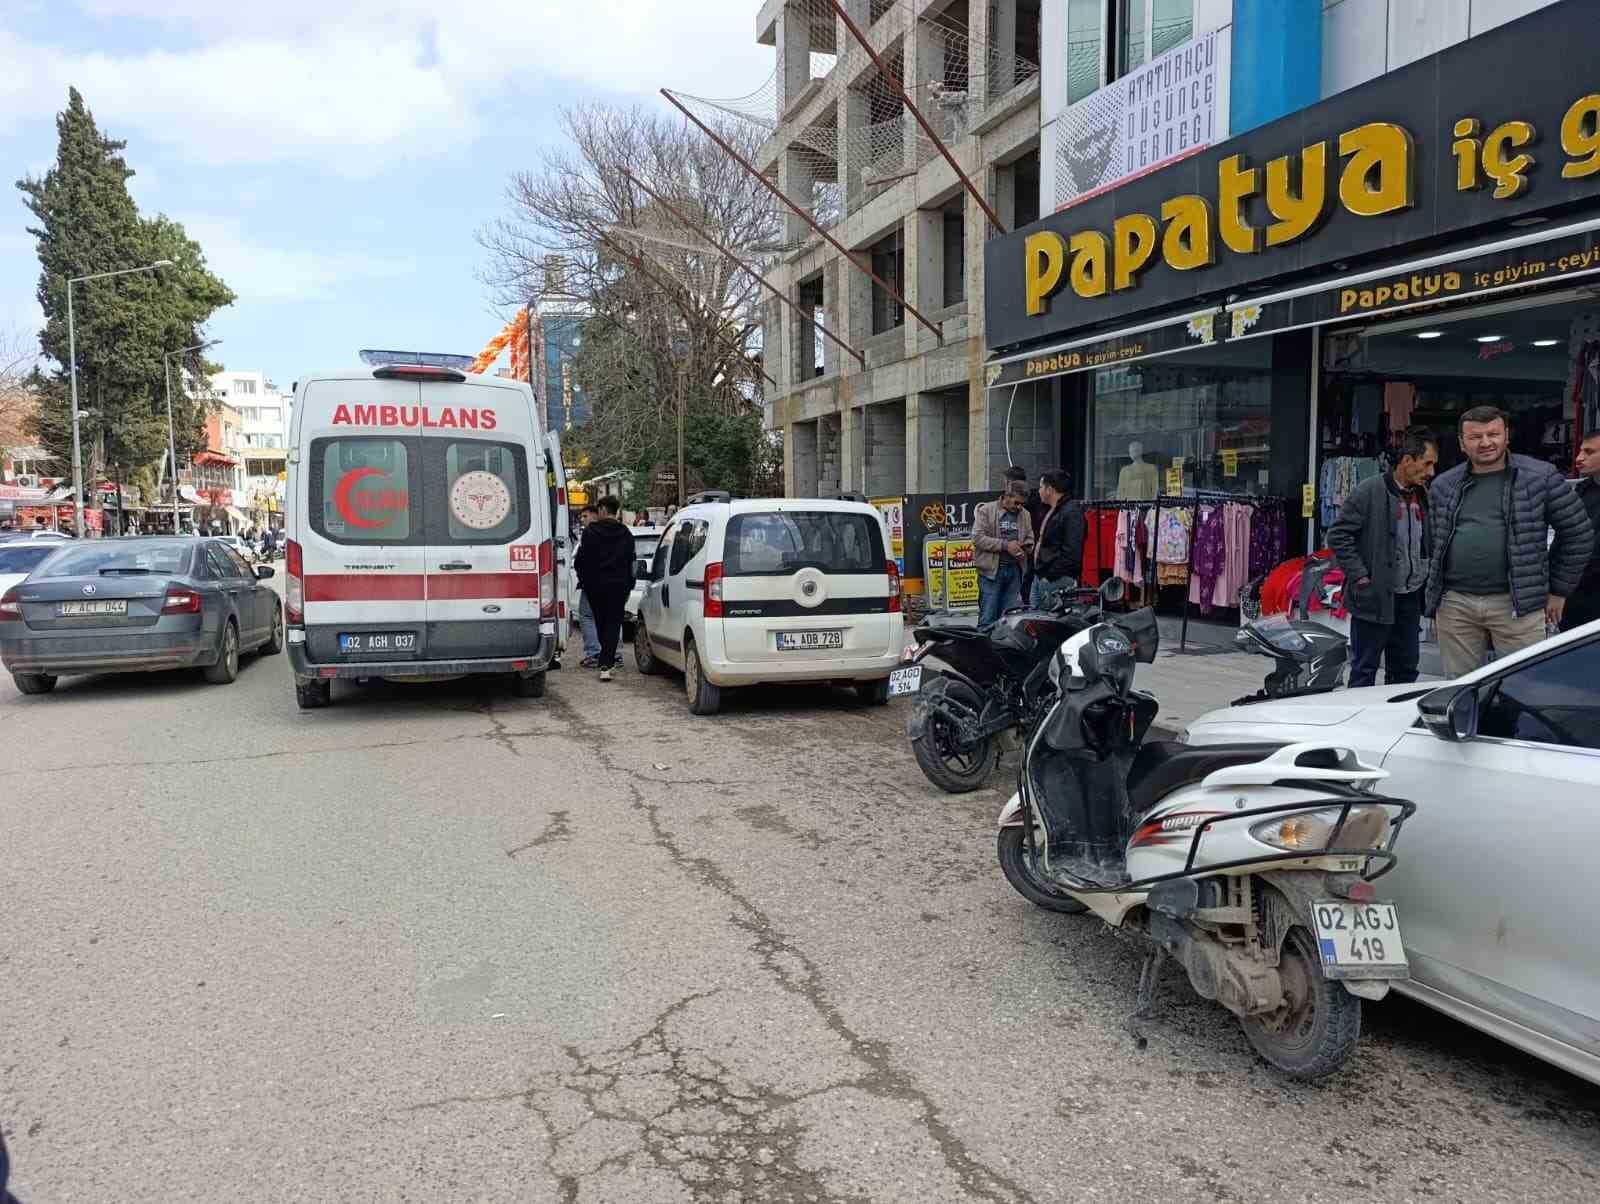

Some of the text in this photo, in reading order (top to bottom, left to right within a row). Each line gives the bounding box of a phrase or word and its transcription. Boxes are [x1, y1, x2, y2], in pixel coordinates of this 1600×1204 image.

[1128, 32, 1214, 107] ATATÜRKÇÜ
[1127, 74, 1213, 139] DÜŞÜNCE
[332, 404, 497, 430] AMBULANS
[513, 547, 533, 560] 112
[347, 635, 414, 649] 02 AGH 037
[783, 633, 796, 645] 44
[823, 631, 841, 645] 728
[1318, 905, 1395, 931] 02 AGJ
[1350, 937, 1384, 961] 419
